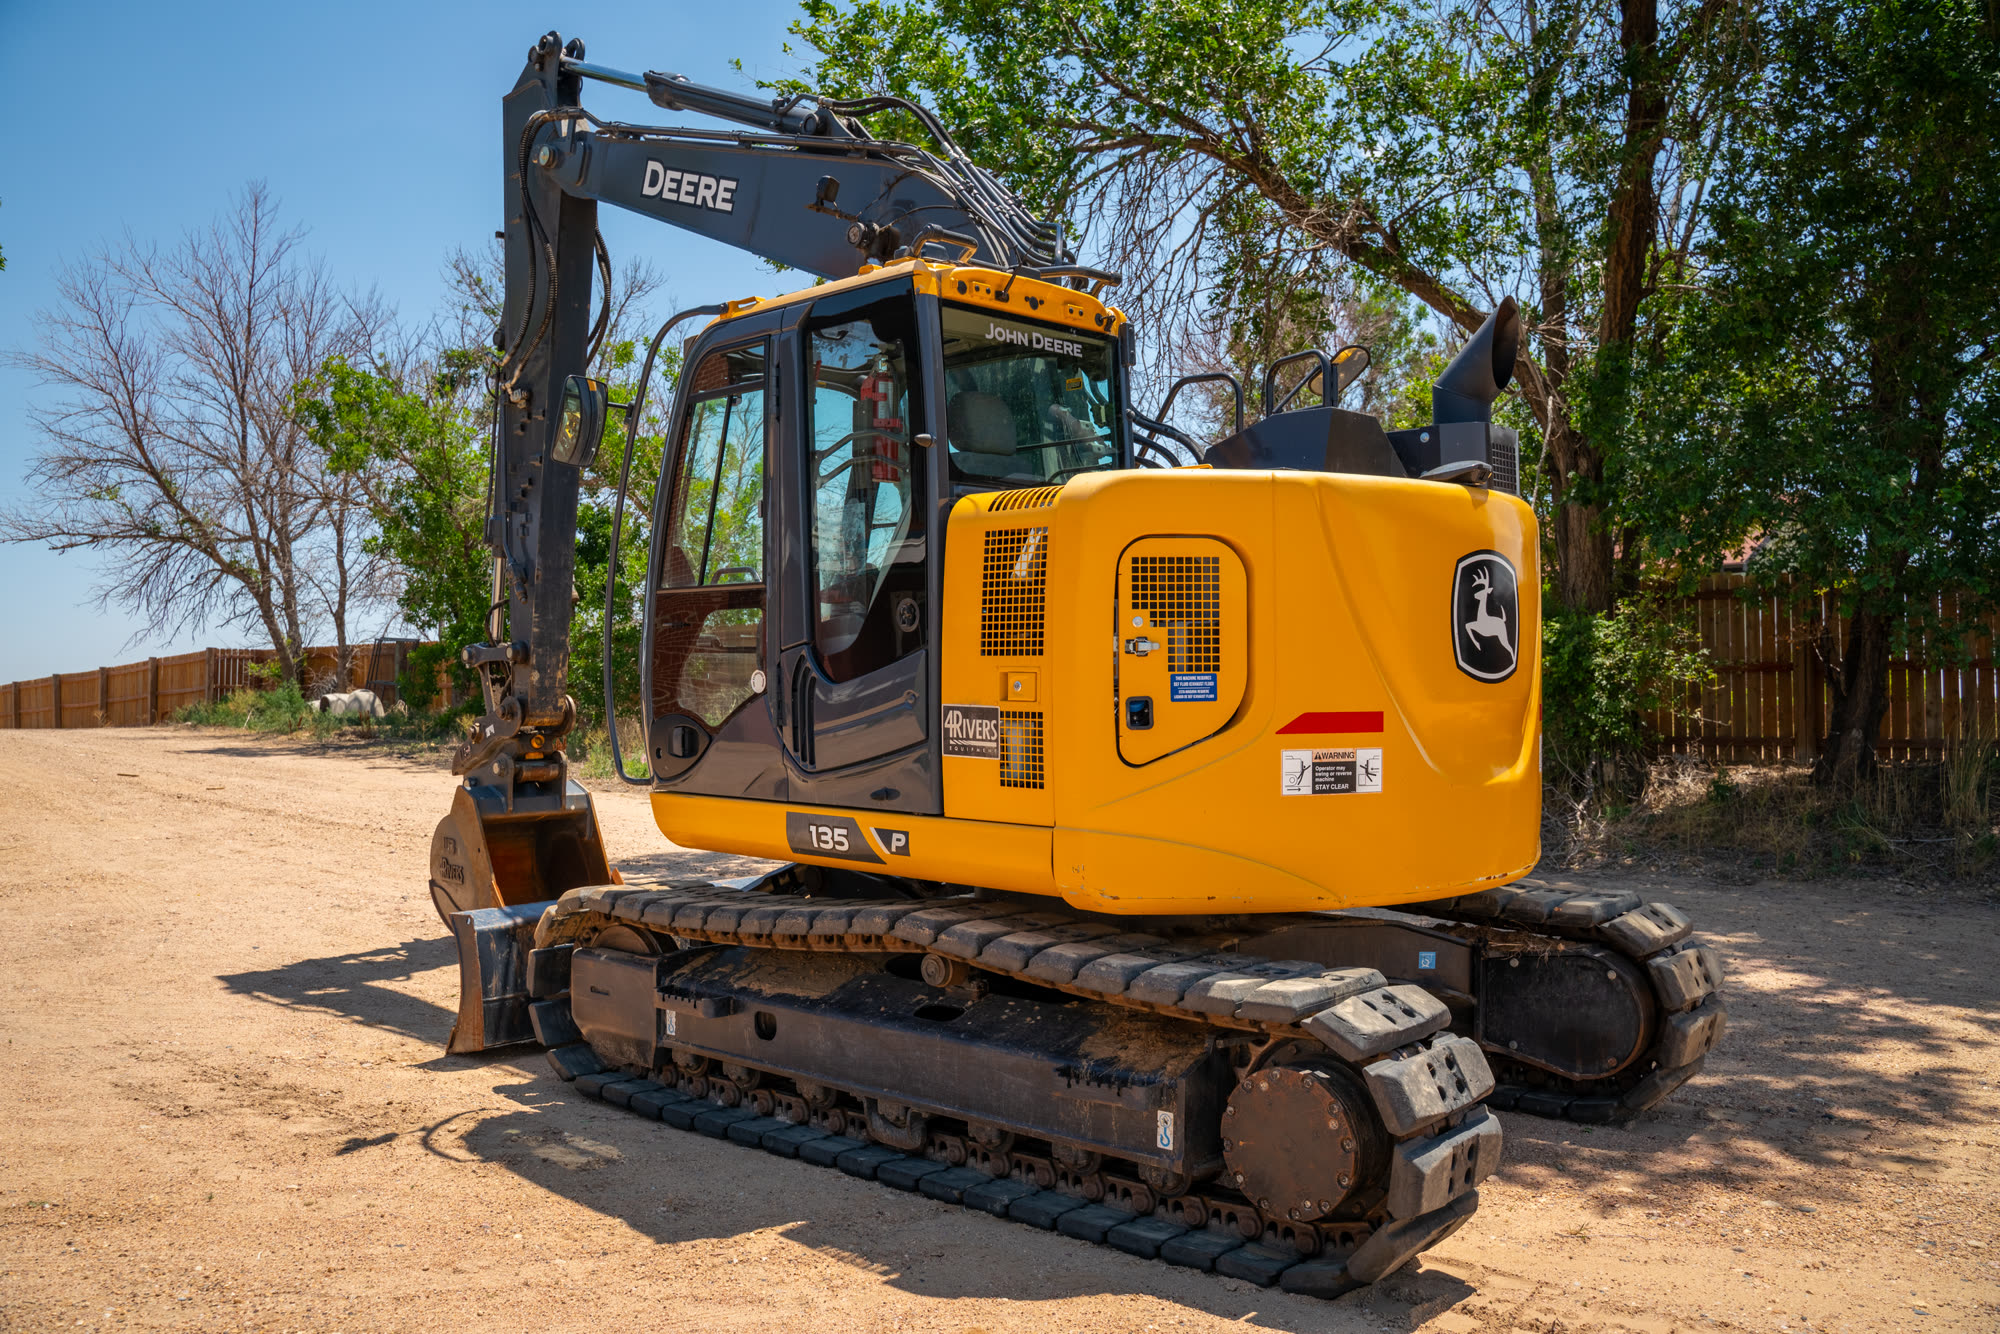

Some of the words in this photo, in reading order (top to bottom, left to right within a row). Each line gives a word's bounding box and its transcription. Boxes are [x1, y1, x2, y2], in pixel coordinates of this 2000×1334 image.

[642, 160, 737, 211] DEERE
[985, 323, 1029, 347] JOHN
[1032, 332, 1083, 357] DEERE
[809, 825, 850, 851] 135
[891, 832, 906, 852] P
